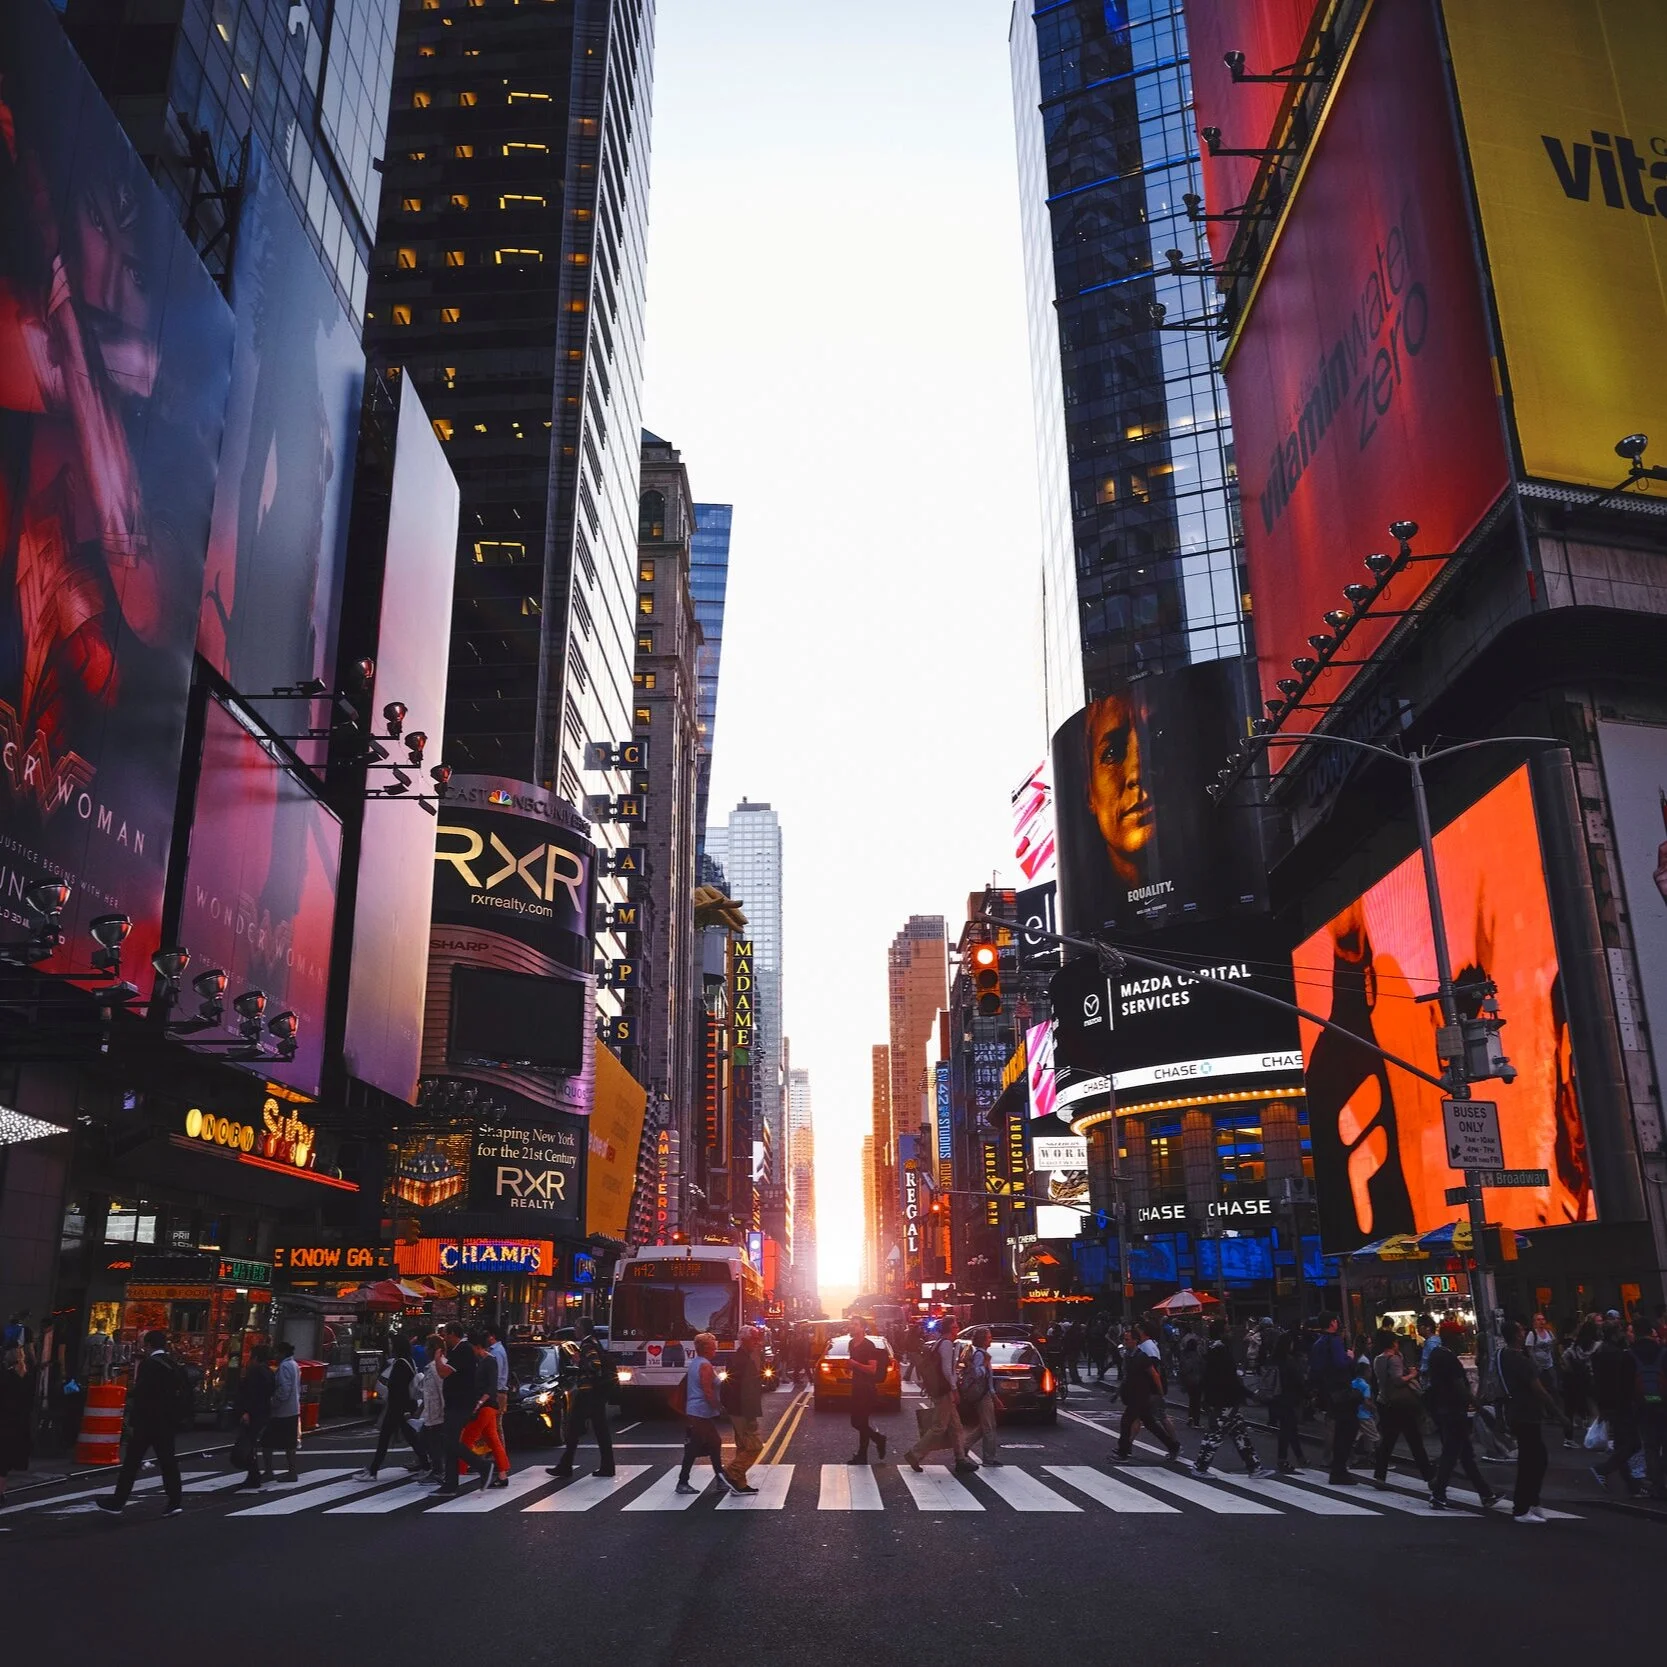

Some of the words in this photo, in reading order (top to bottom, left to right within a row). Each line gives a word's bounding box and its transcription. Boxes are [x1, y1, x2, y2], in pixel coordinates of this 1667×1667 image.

[1356, 281, 1427, 451] zero
[58, 775, 146, 856] WOMAN
[43, 858, 77, 885] BEGINS
[435, 825, 583, 914] RXR
[616, 745, 640, 1040] CHAMPS
[1127, 880, 1175, 903] EQUALITY.
[471, 893, 553, 918] rxrrealty.com
[196, 885, 266, 950] WONDER
[275, 938, 325, 981] WOMAN
[430, 939, 489, 952] SHARP
[734, 941, 752, 1046] MADAME
[1120, 975, 1172, 998] MAZDA
[1122, 991, 1190, 1016] SERVICES
[1083, 1078, 1109, 1094] CHASE
[1154, 1064, 1197, 1080] CHASE
[1453, 1106, 1487, 1119] BUSES
[532, 1128, 556, 1143] New
[557, 1131, 575, 1147] York
[939, 1118, 953, 1160] STUDIOS
[1459, 1121, 1484, 1133] ONLY
[477, 1143, 497, 1157] for
[501, 1144, 520, 1159] the
[522, 1147, 543, 1161] 21st
[545, 1149, 577, 1169] Century
[1010, 1115, 1025, 1173] VICTORY
[1041, 1149, 1085, 1158] WORK
[496, 1165, 565, 1201] RXR
[1496, 1172, 1545, 1186] Broadway
[511, 1198, 555, 1210] REALTY
[1012, 1181, 1026, 1209] NW
[904, 1172, 919, 1252] REGAL
[987, 1200, 998, 1225] NEW
[1138, 1204, 1186, 1222] CHASE
[1208, 1199, 1272, 1217] CHASE
[1006, 1234, 1038, 1246] SKCHERS
[290, 1248, 342, 1267] KNOW
[440, 1245, 542, 1270] CHAMPS
[1028, 1289, 1060, 1299] ubwy
[1425, 1276, 1459, 1293] SODA
